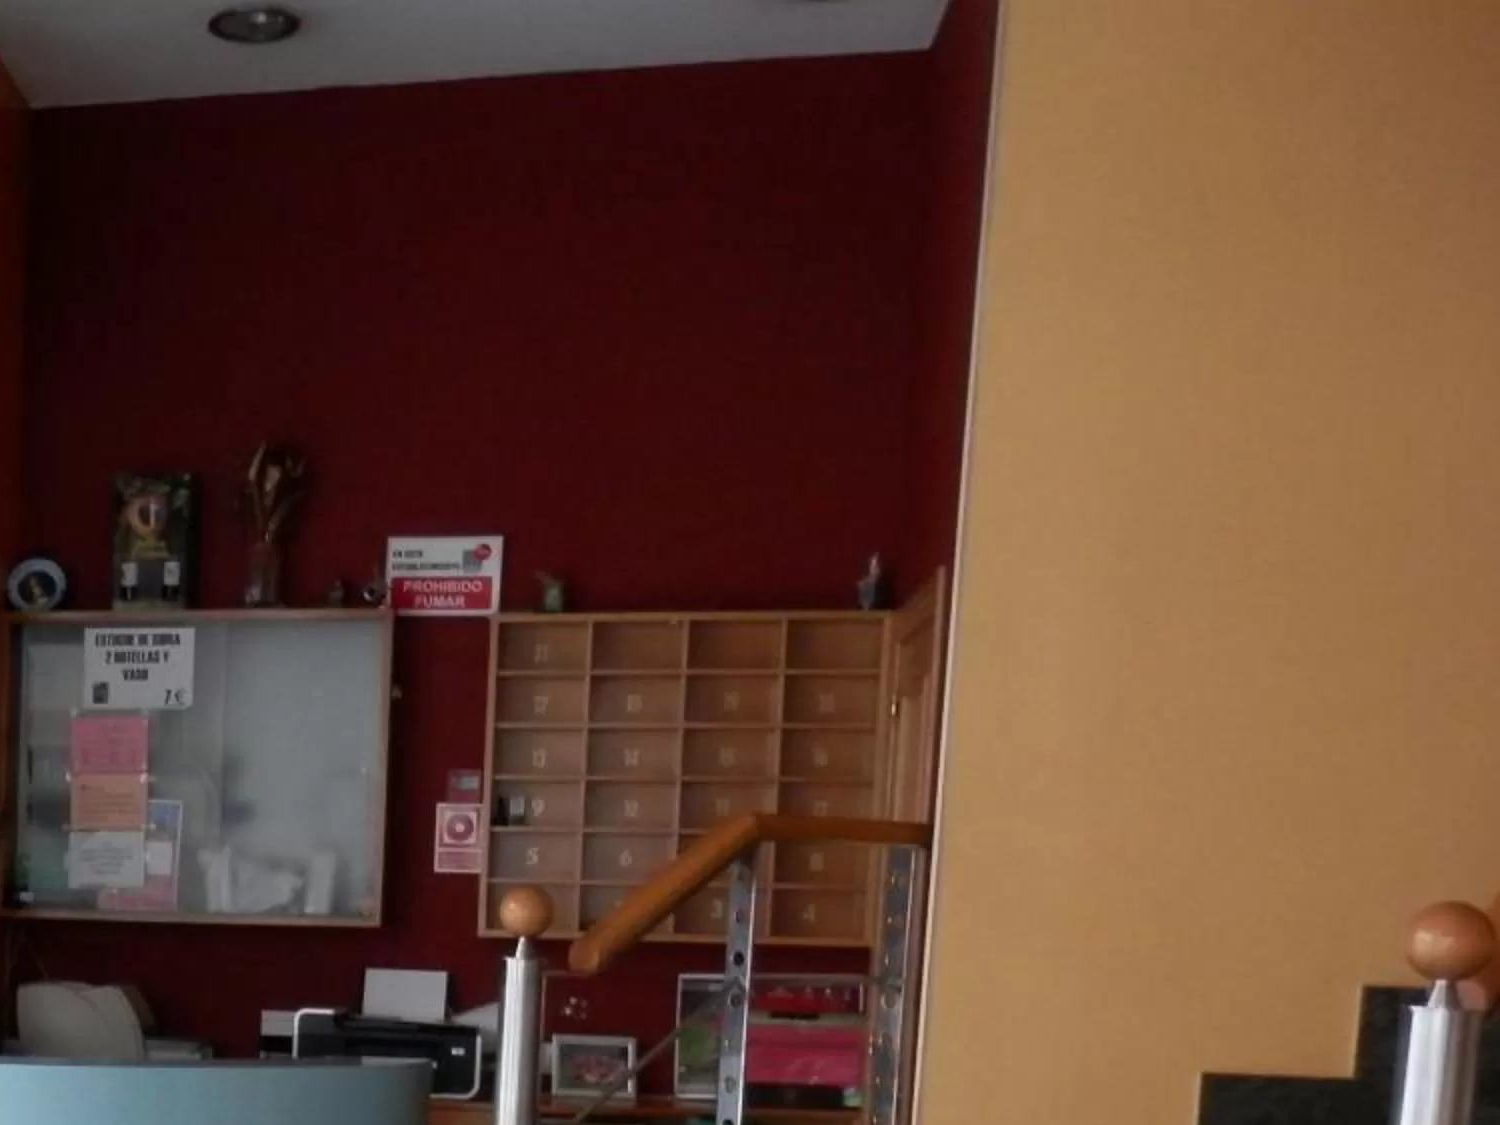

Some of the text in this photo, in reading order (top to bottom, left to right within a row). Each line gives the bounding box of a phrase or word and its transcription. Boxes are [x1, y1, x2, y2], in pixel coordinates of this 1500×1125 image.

[402, 579, 484, 593] PROHIBIDO
[414, 595, 466, 609] FUMAR
[525, 847, 540, 865] 5
[618, 849, 633, 867] 6
[710, 898, 724, 919] 3
